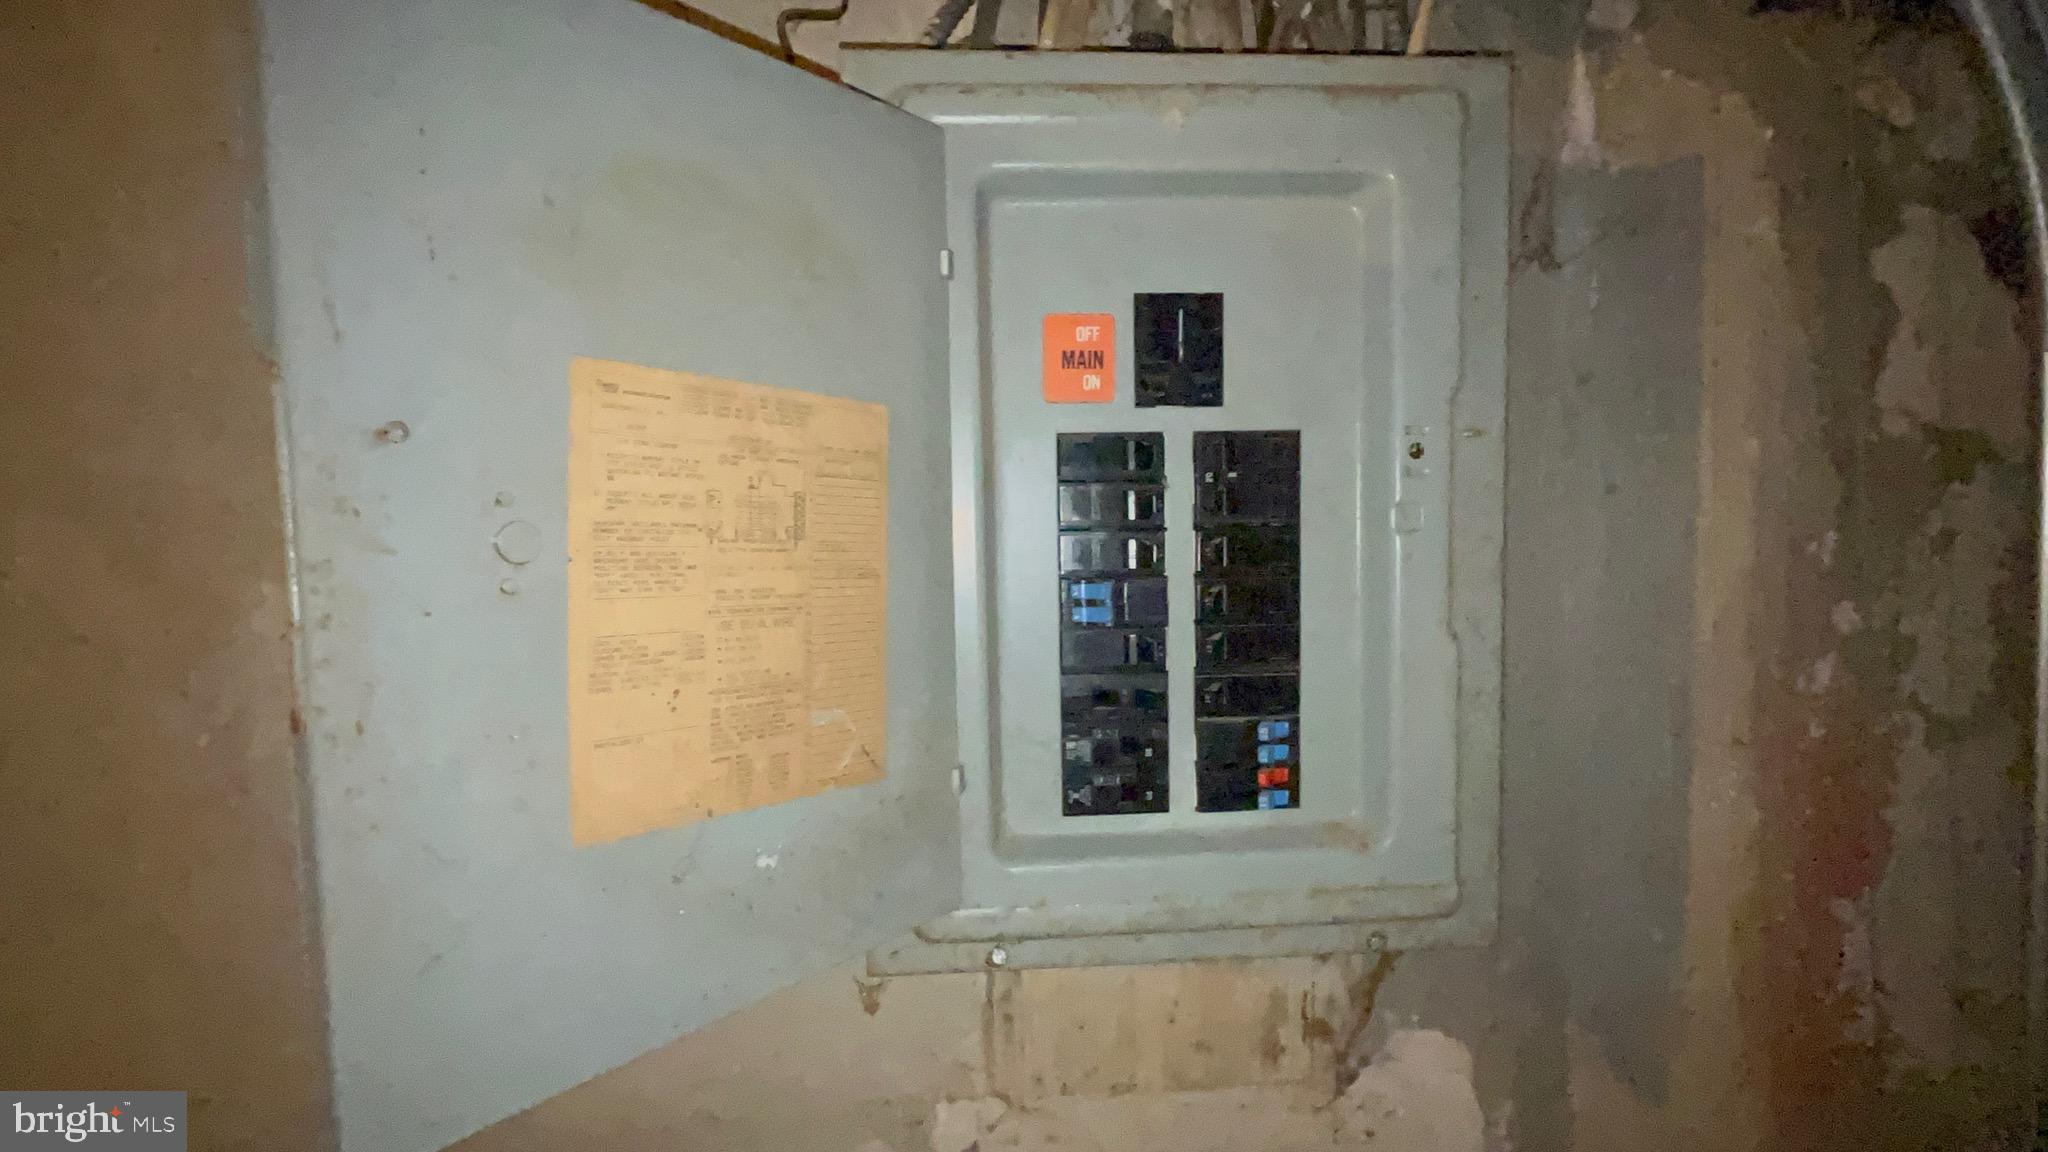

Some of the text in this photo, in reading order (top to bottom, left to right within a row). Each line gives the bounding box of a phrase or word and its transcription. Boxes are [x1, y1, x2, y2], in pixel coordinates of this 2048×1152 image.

[1076, 326, 1100, 342] OFF
[1061, 350, 1104, 369] MAIN
[1082, 374, 1101, 391] ON
